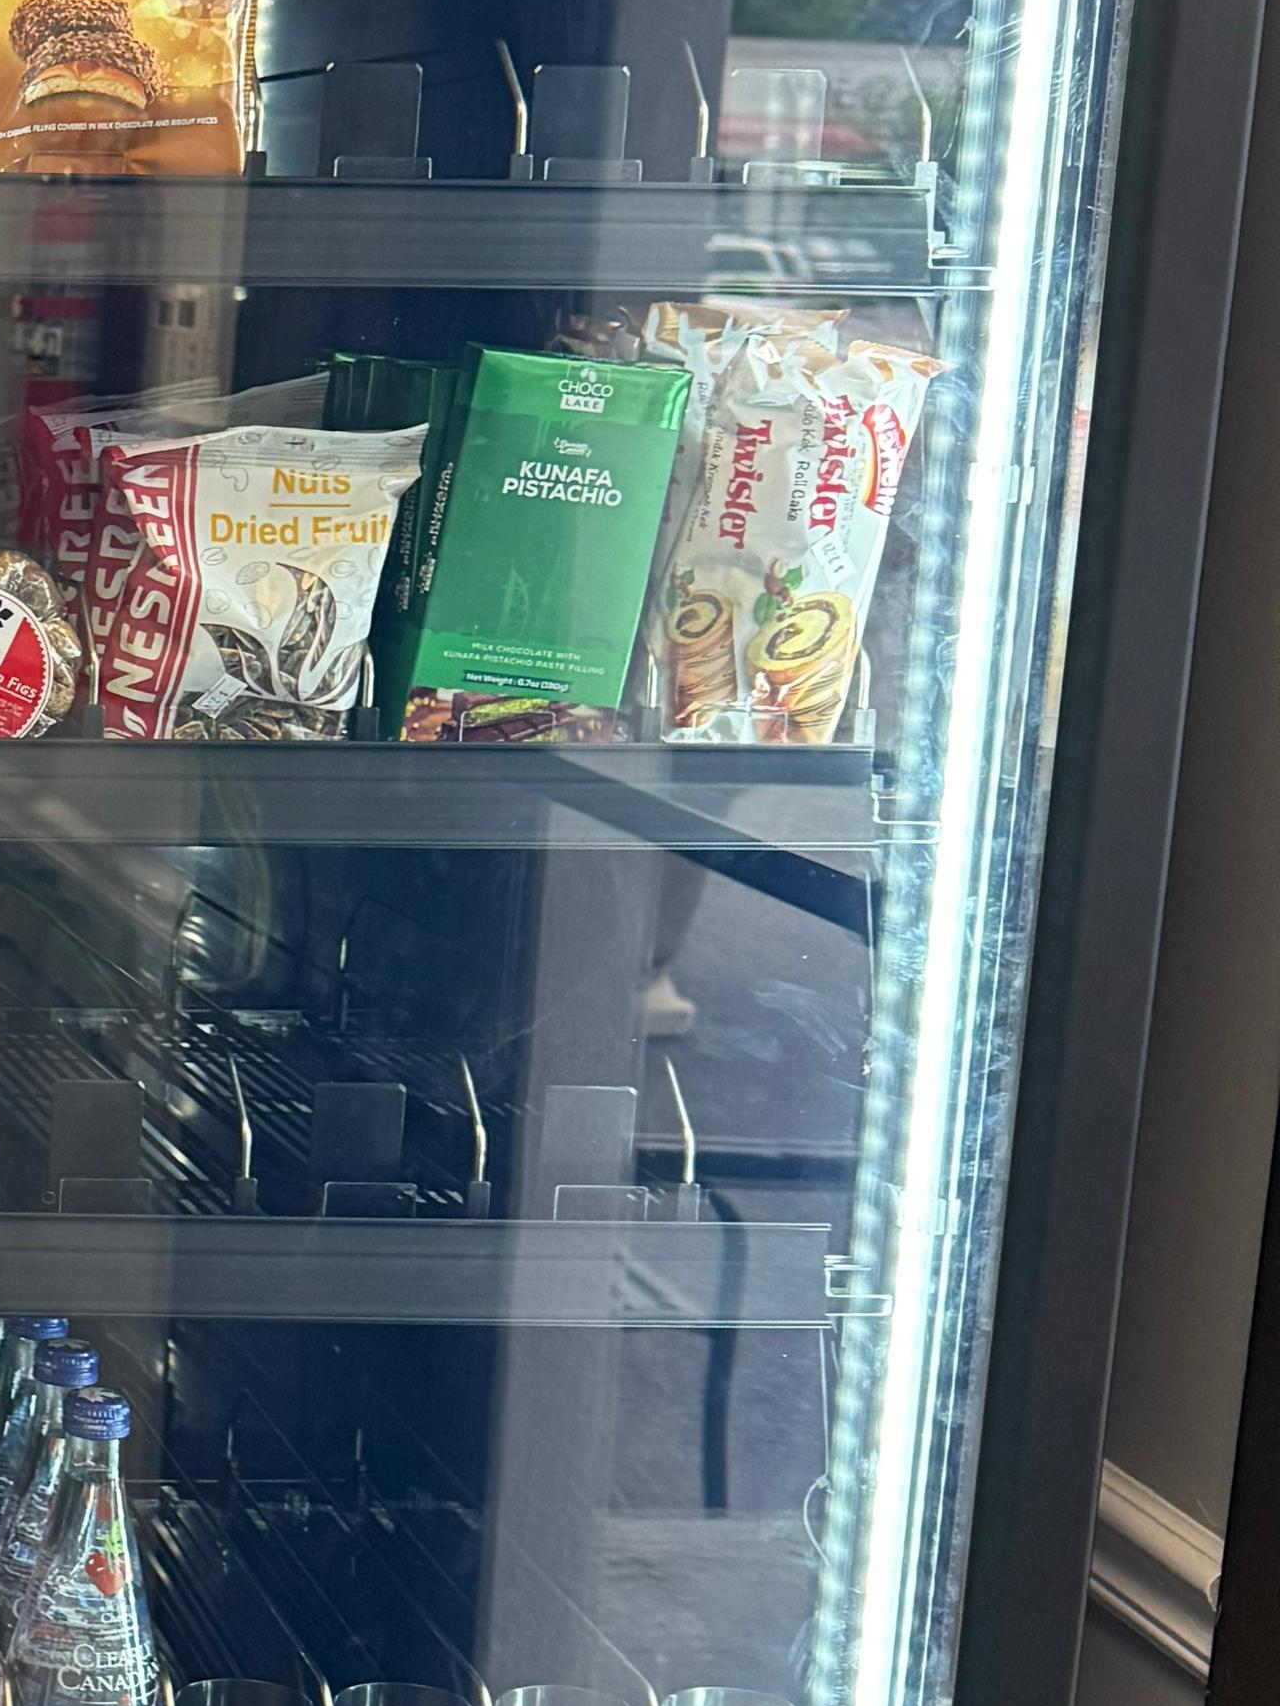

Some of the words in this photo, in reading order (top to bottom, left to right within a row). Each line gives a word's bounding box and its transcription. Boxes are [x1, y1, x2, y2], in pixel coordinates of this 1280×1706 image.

[558, 379, 613, 398] CHOCO
[564, 397, 601, 411] LAKE
[519, 460, 613, 487] KUNAFA
[807, 394, 855, 537] Twister
[272, 467, 351, 495] Nuts
[502, 476, 622, 507] PISTACHIO
[719, 420, 773, 550] Twister
[787, 489, 805, 523] Cake
[210, 513, 299, 545] Dried
[6, 677, 38, 699] FIGS
